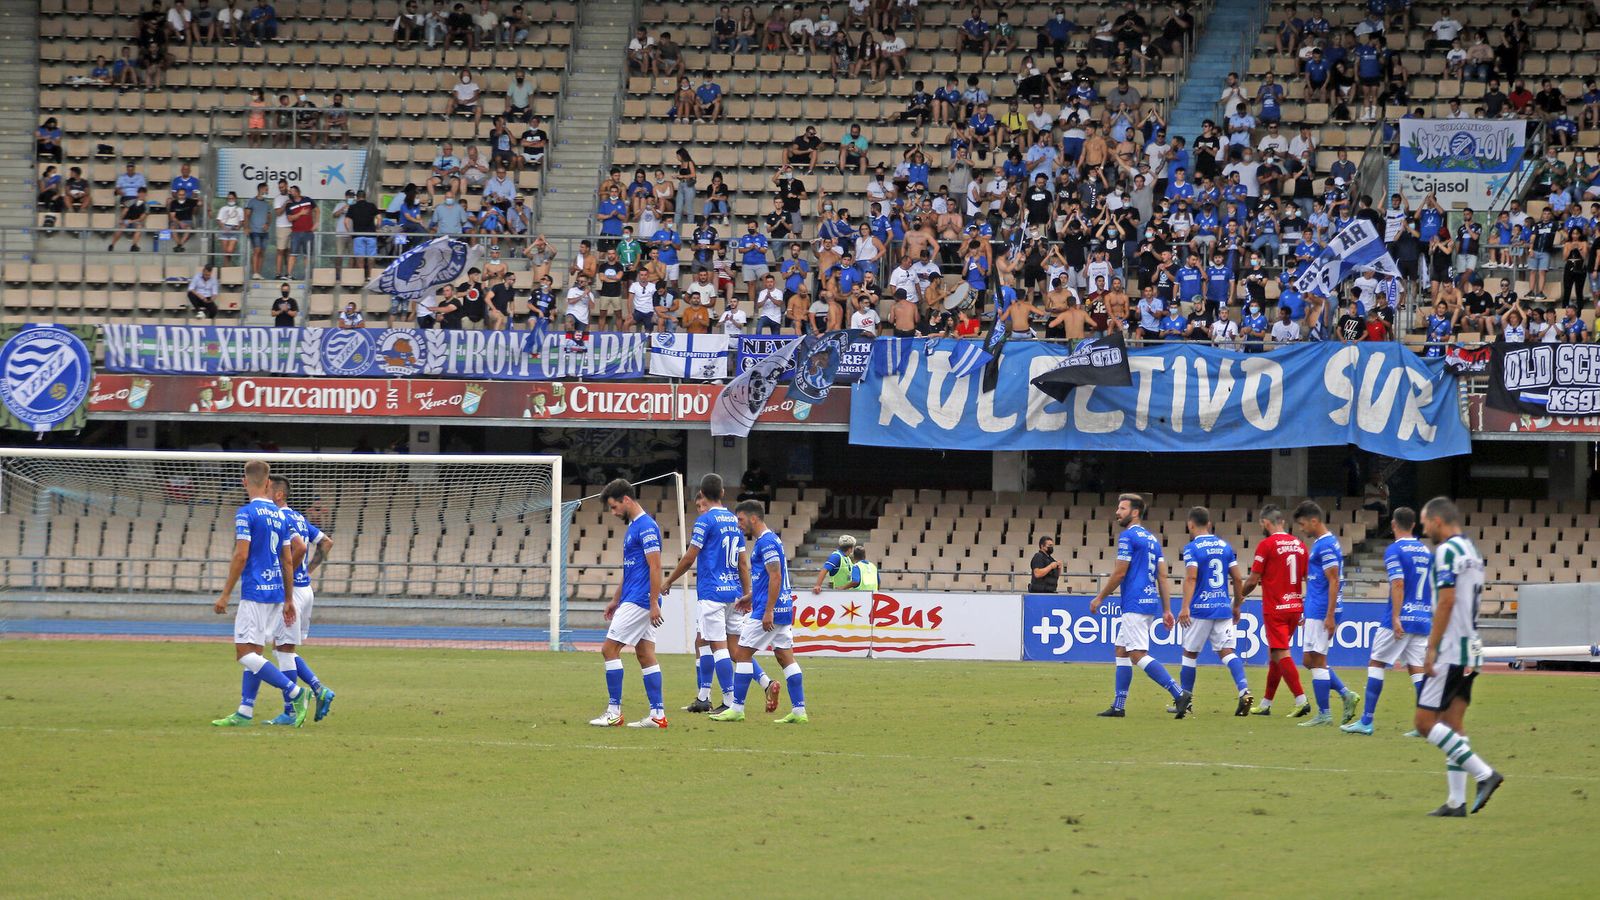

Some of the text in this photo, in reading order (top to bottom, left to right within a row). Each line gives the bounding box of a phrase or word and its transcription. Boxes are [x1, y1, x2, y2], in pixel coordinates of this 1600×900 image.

[1434, 122, 1493, 131] KOMANDO
[242, 166, 302, 182] Cajasol
[1413, 177, 1469, 194] Cajasol
[104, 324, 300, 374] WE ARE XEREZ
[446, 330, 530, 377] FROM
[1504, 345, 1553, 391] OLD
[237, 379, 378, 414] Cruzcampo
[386, 388, 399, 409] SIN
[414, 387, 434, 400] and
[569, 385, 710, 418] Cruzcampo
[1323, 345, 1438, 442] SUR
[721, 535, 740, 570] 16
[1286, 553, 1298, 585] 1
[1208, 558, 1225, 589] 3
[1415, 566, 1429, 601] 7
[869, 593, 943, 629] Bus
